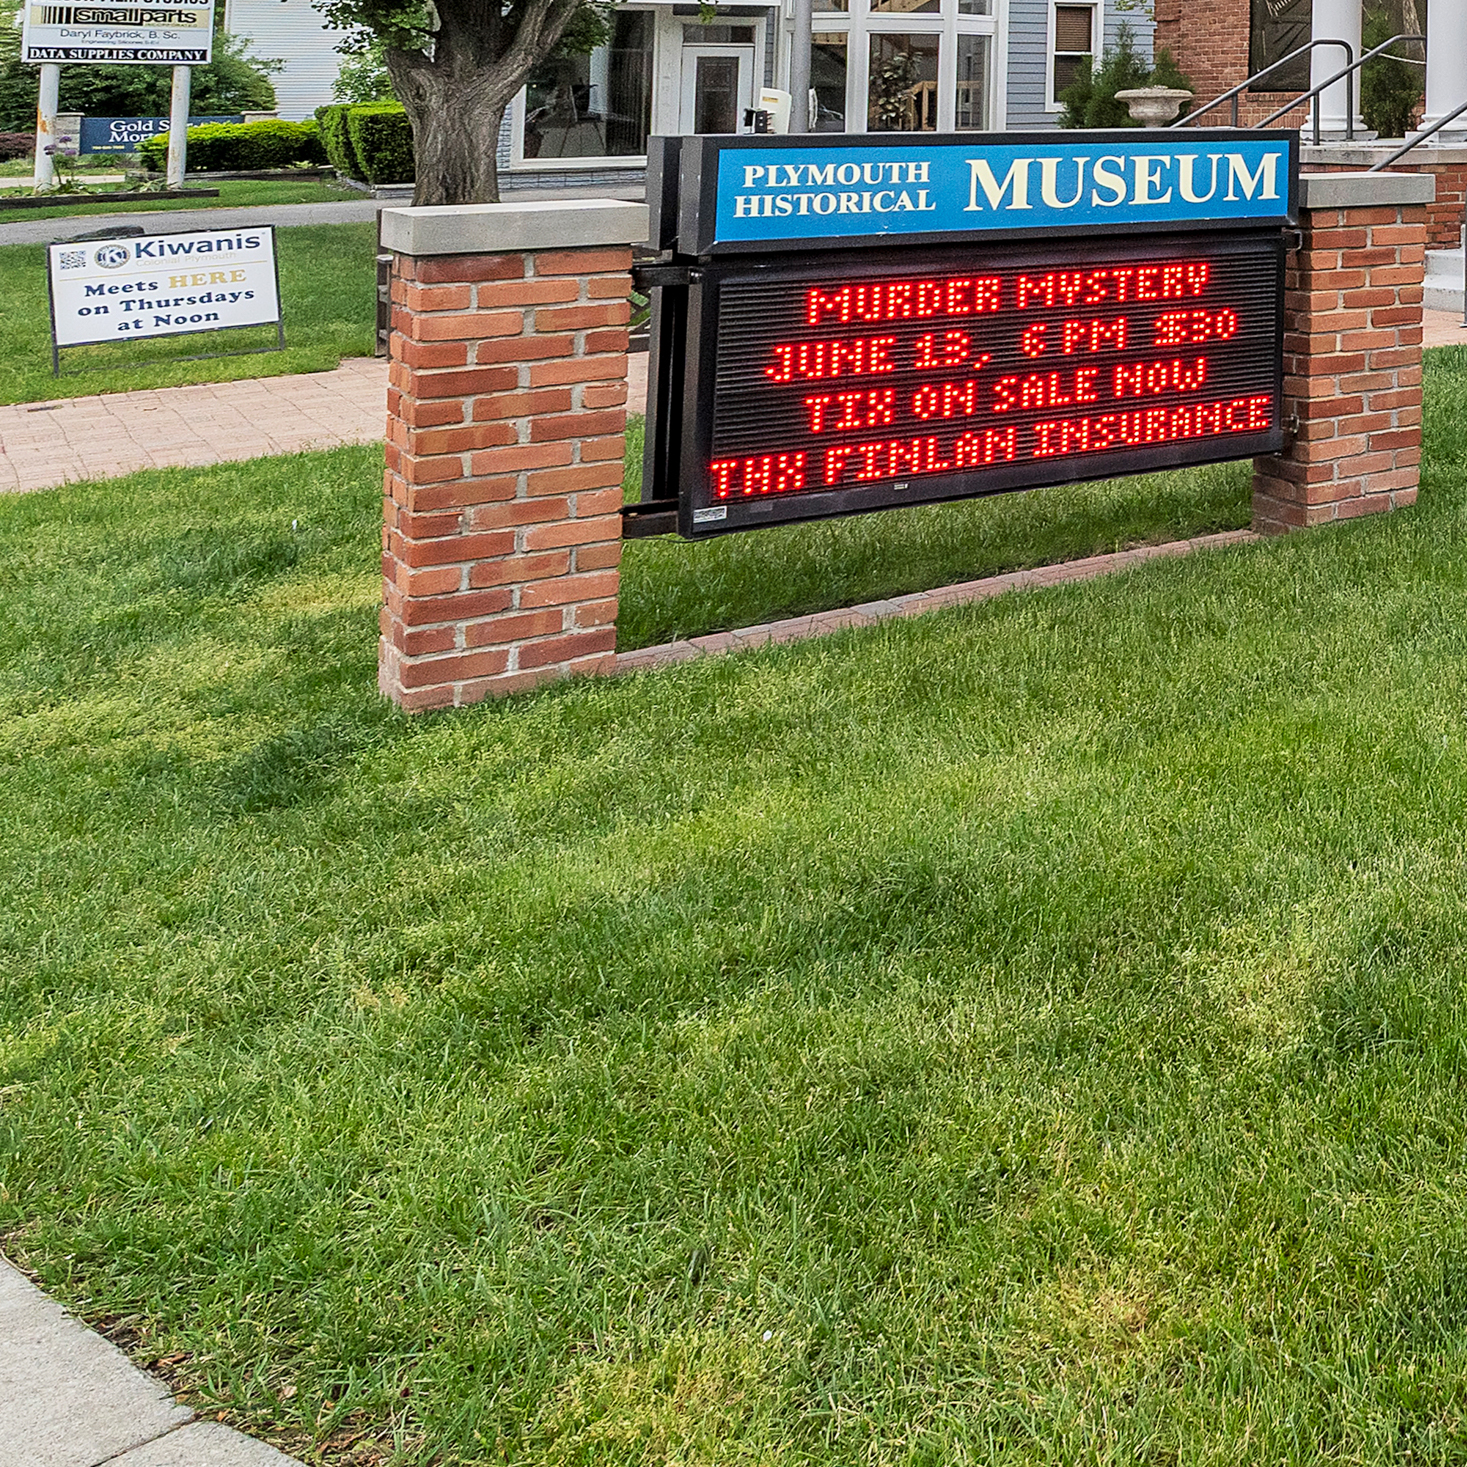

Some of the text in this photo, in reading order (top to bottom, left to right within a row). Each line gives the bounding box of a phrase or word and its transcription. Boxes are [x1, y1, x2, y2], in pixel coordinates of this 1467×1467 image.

[60, 29, 92, 39] Daryl
[148, 31, 160, 39] B.
[162, 31, 180, 39] Sc.
[30, 49, 203, 61] DATA SUPPLIES COMPANY
[109, 120, 152, 132] Gold
[742, 161, 931, 188] PLYMOUTH
[963, 152, 1283, 213] MUSEUM
[732, 189, 938, 218] HISTORICAL
[135, 233, 260, 258] Kiwanis
[136, 251, 237, 267] Colonial Plymouth
[84, 269, 247, 297] Meets HERE
[807, 264, 1209, 325] MURDER MYSTERY
[77, 289, 255, 317] on Thursdays
[117, 312, 220, 331] at Noon
[765, 336, 895, 382] JUNE
[915, 330, 991, 370] 13,
[1063, 317, 1127, 355] PM
[1155, 307, 1237, 347] $30
[805, 357, 1206, 432] TIX ON SALE NOW
[711, 394, 1271, 500] THX FINLAN INSURANCE
